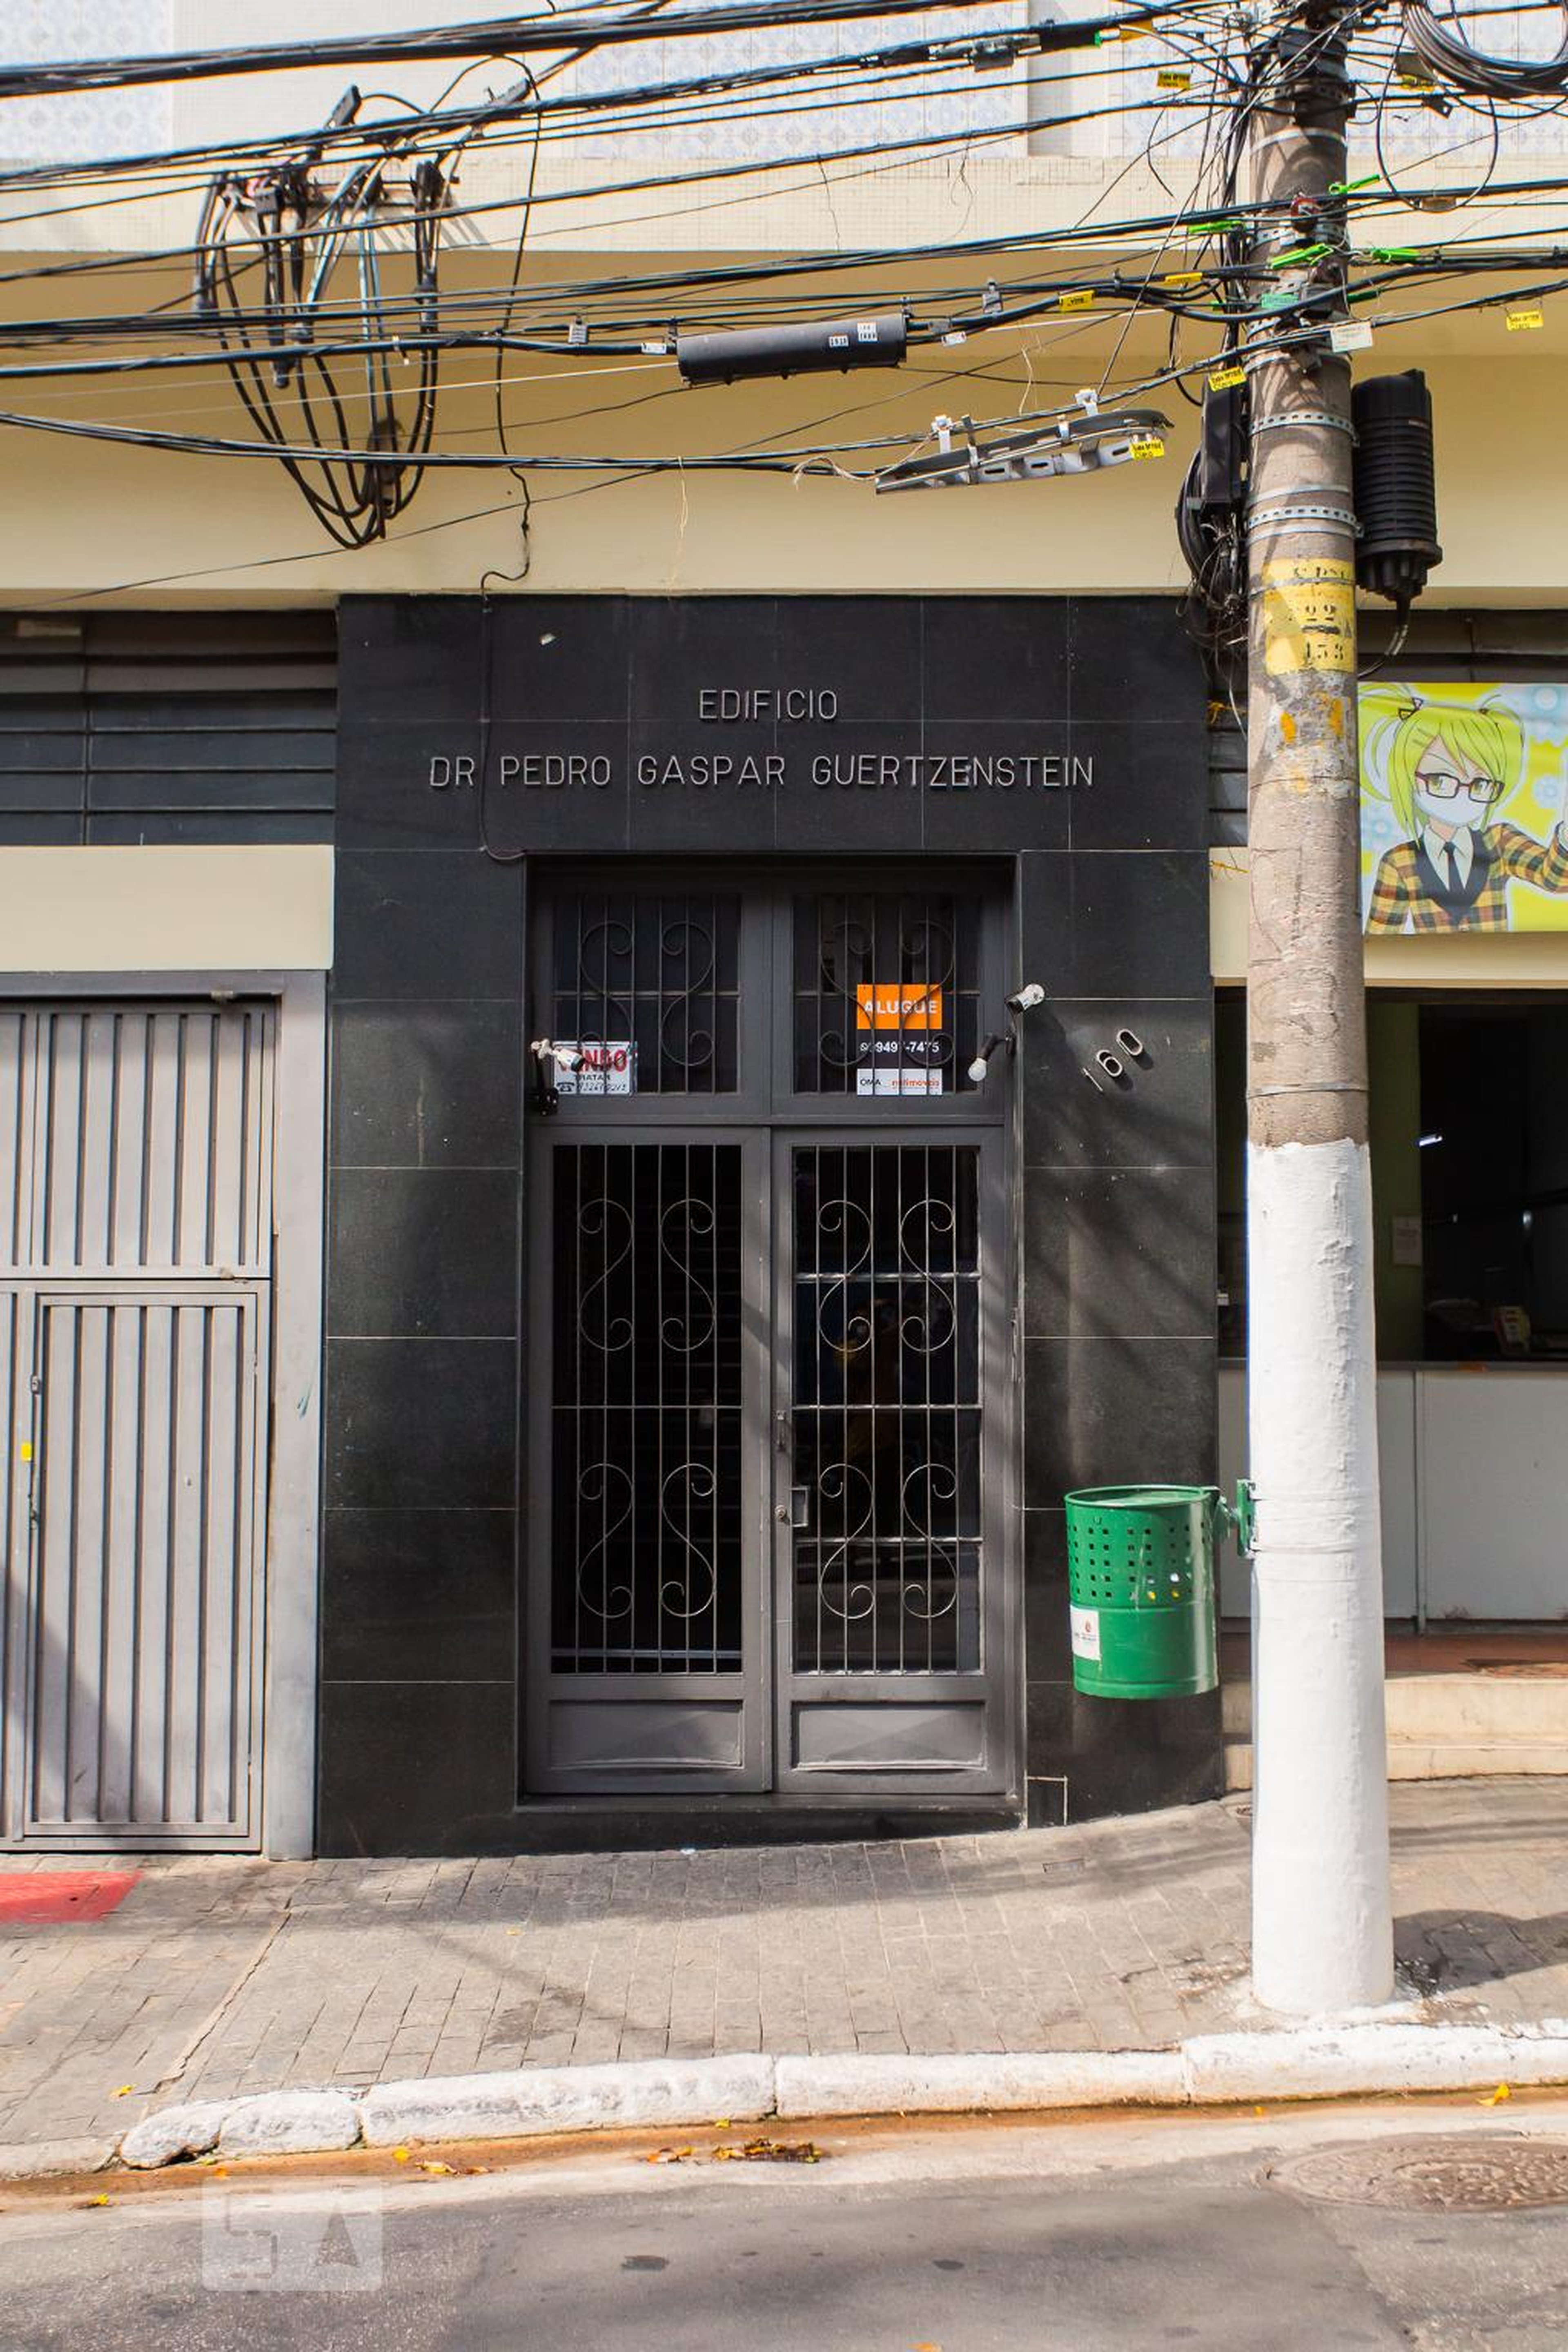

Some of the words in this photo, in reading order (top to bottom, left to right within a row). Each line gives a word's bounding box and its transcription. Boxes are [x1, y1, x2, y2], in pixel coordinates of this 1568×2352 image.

[699, 689, 837, 720] EDIFICIO
[430, 756, 475, 786] DR
[501, 755, 611, 786] PEDRO
[637, 755, 785, 786] GASPAR
[812, 754, 1093, 787] GUERTZENSTEIN
[558, 1049, 628, 1072] NDO
